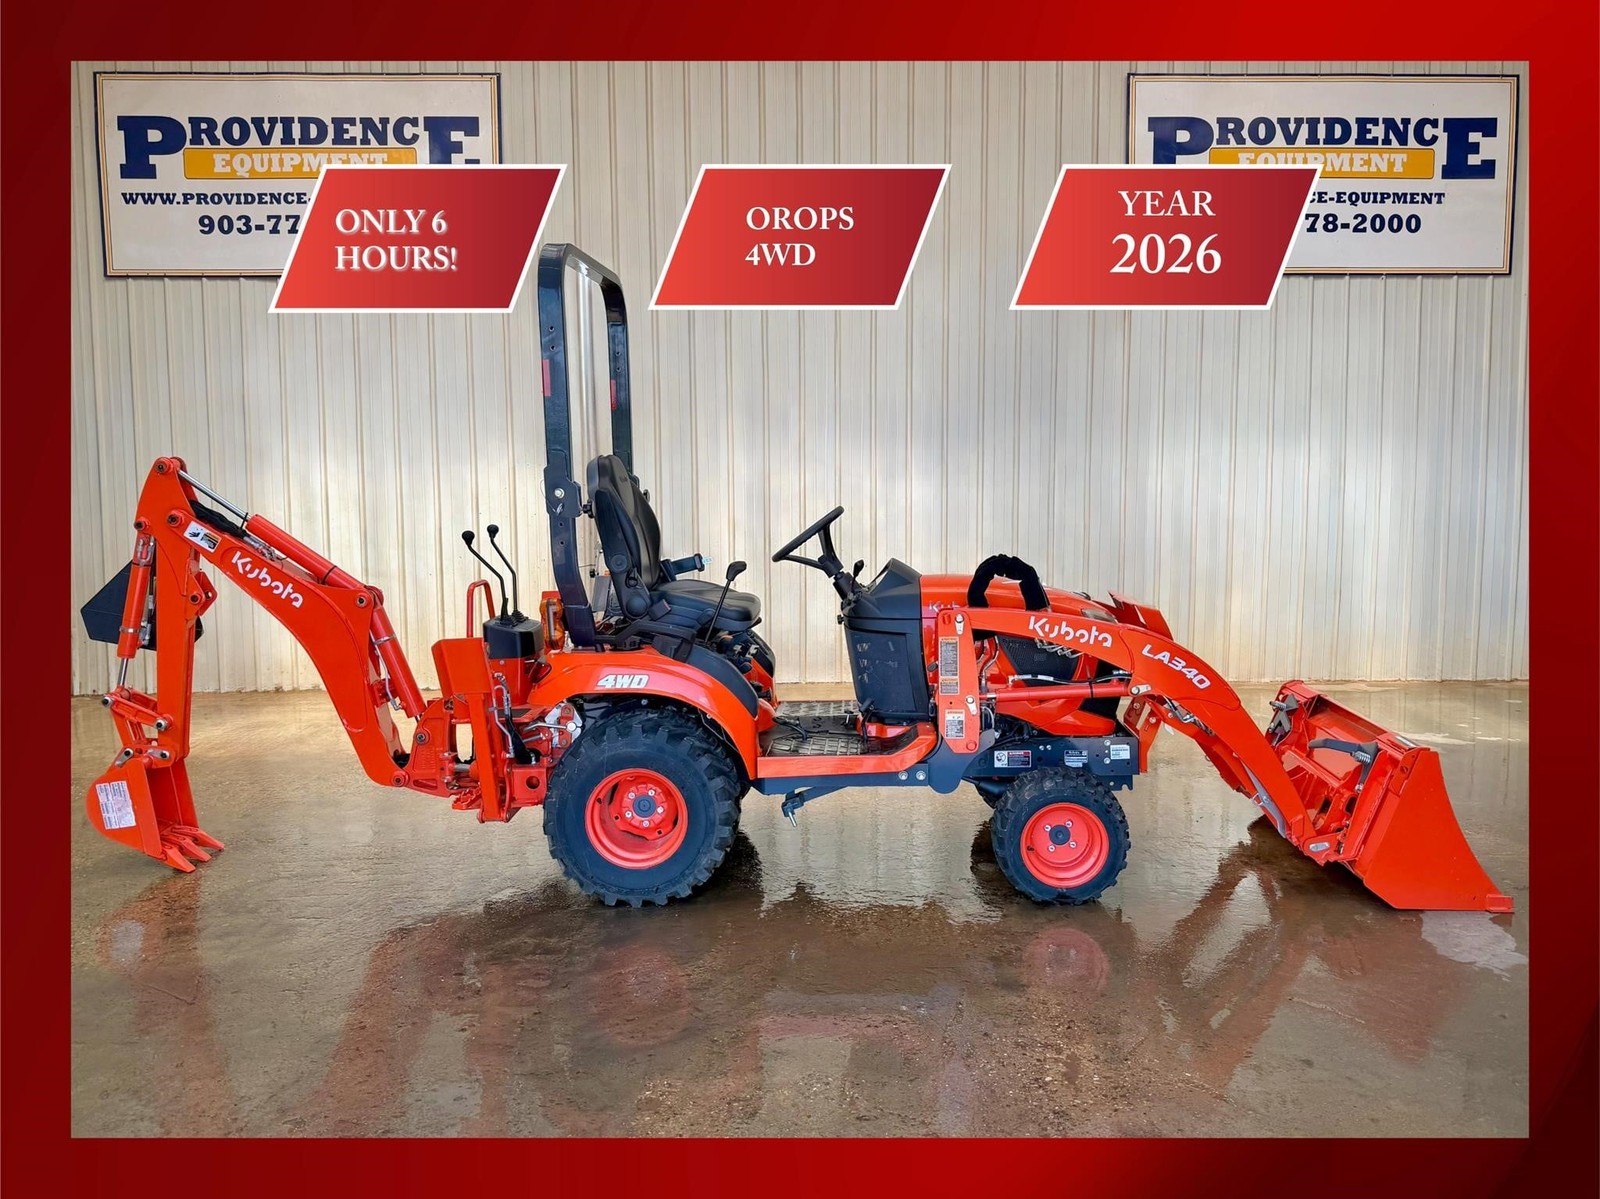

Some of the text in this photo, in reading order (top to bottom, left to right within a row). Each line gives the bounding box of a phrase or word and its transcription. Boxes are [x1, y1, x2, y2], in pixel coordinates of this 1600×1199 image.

[117, 115, 480, 179] PROVIDENCE
[213, 152, 388, 178] EQUIPMENT
[1148, 116, 1498, 180] PROVIDENCE
[231, 550, 304, 609] Kubota
[1028, 615, 1113, 648] Kubota
[596, 674, 650, 690] 4WD
[1141, 643, 1212, 690] LA340
